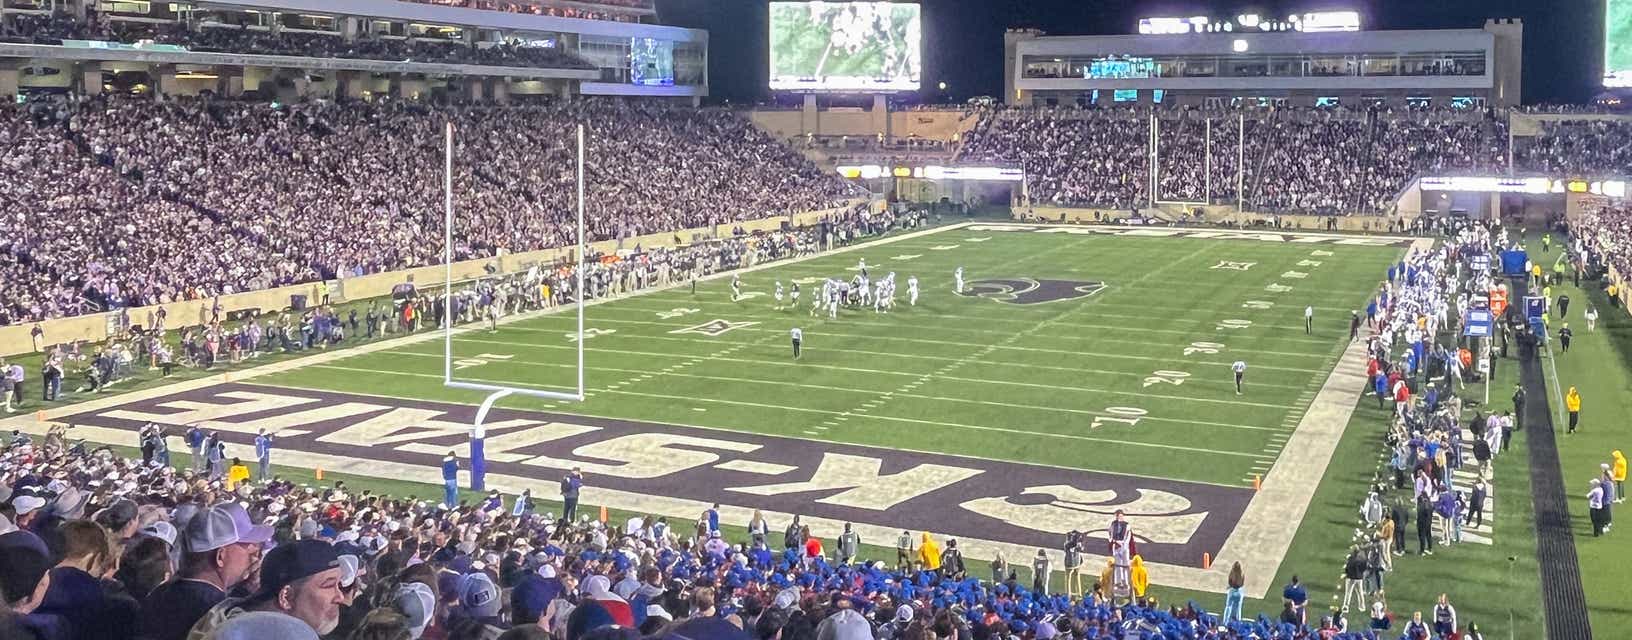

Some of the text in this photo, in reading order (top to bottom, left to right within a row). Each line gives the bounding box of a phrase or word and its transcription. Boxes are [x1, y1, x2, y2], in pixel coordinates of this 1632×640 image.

[1144, 370, 1192, 386] 20
[1094, 406, 1149, 426] 10
[97, 391, 985, 511] K-STATE
